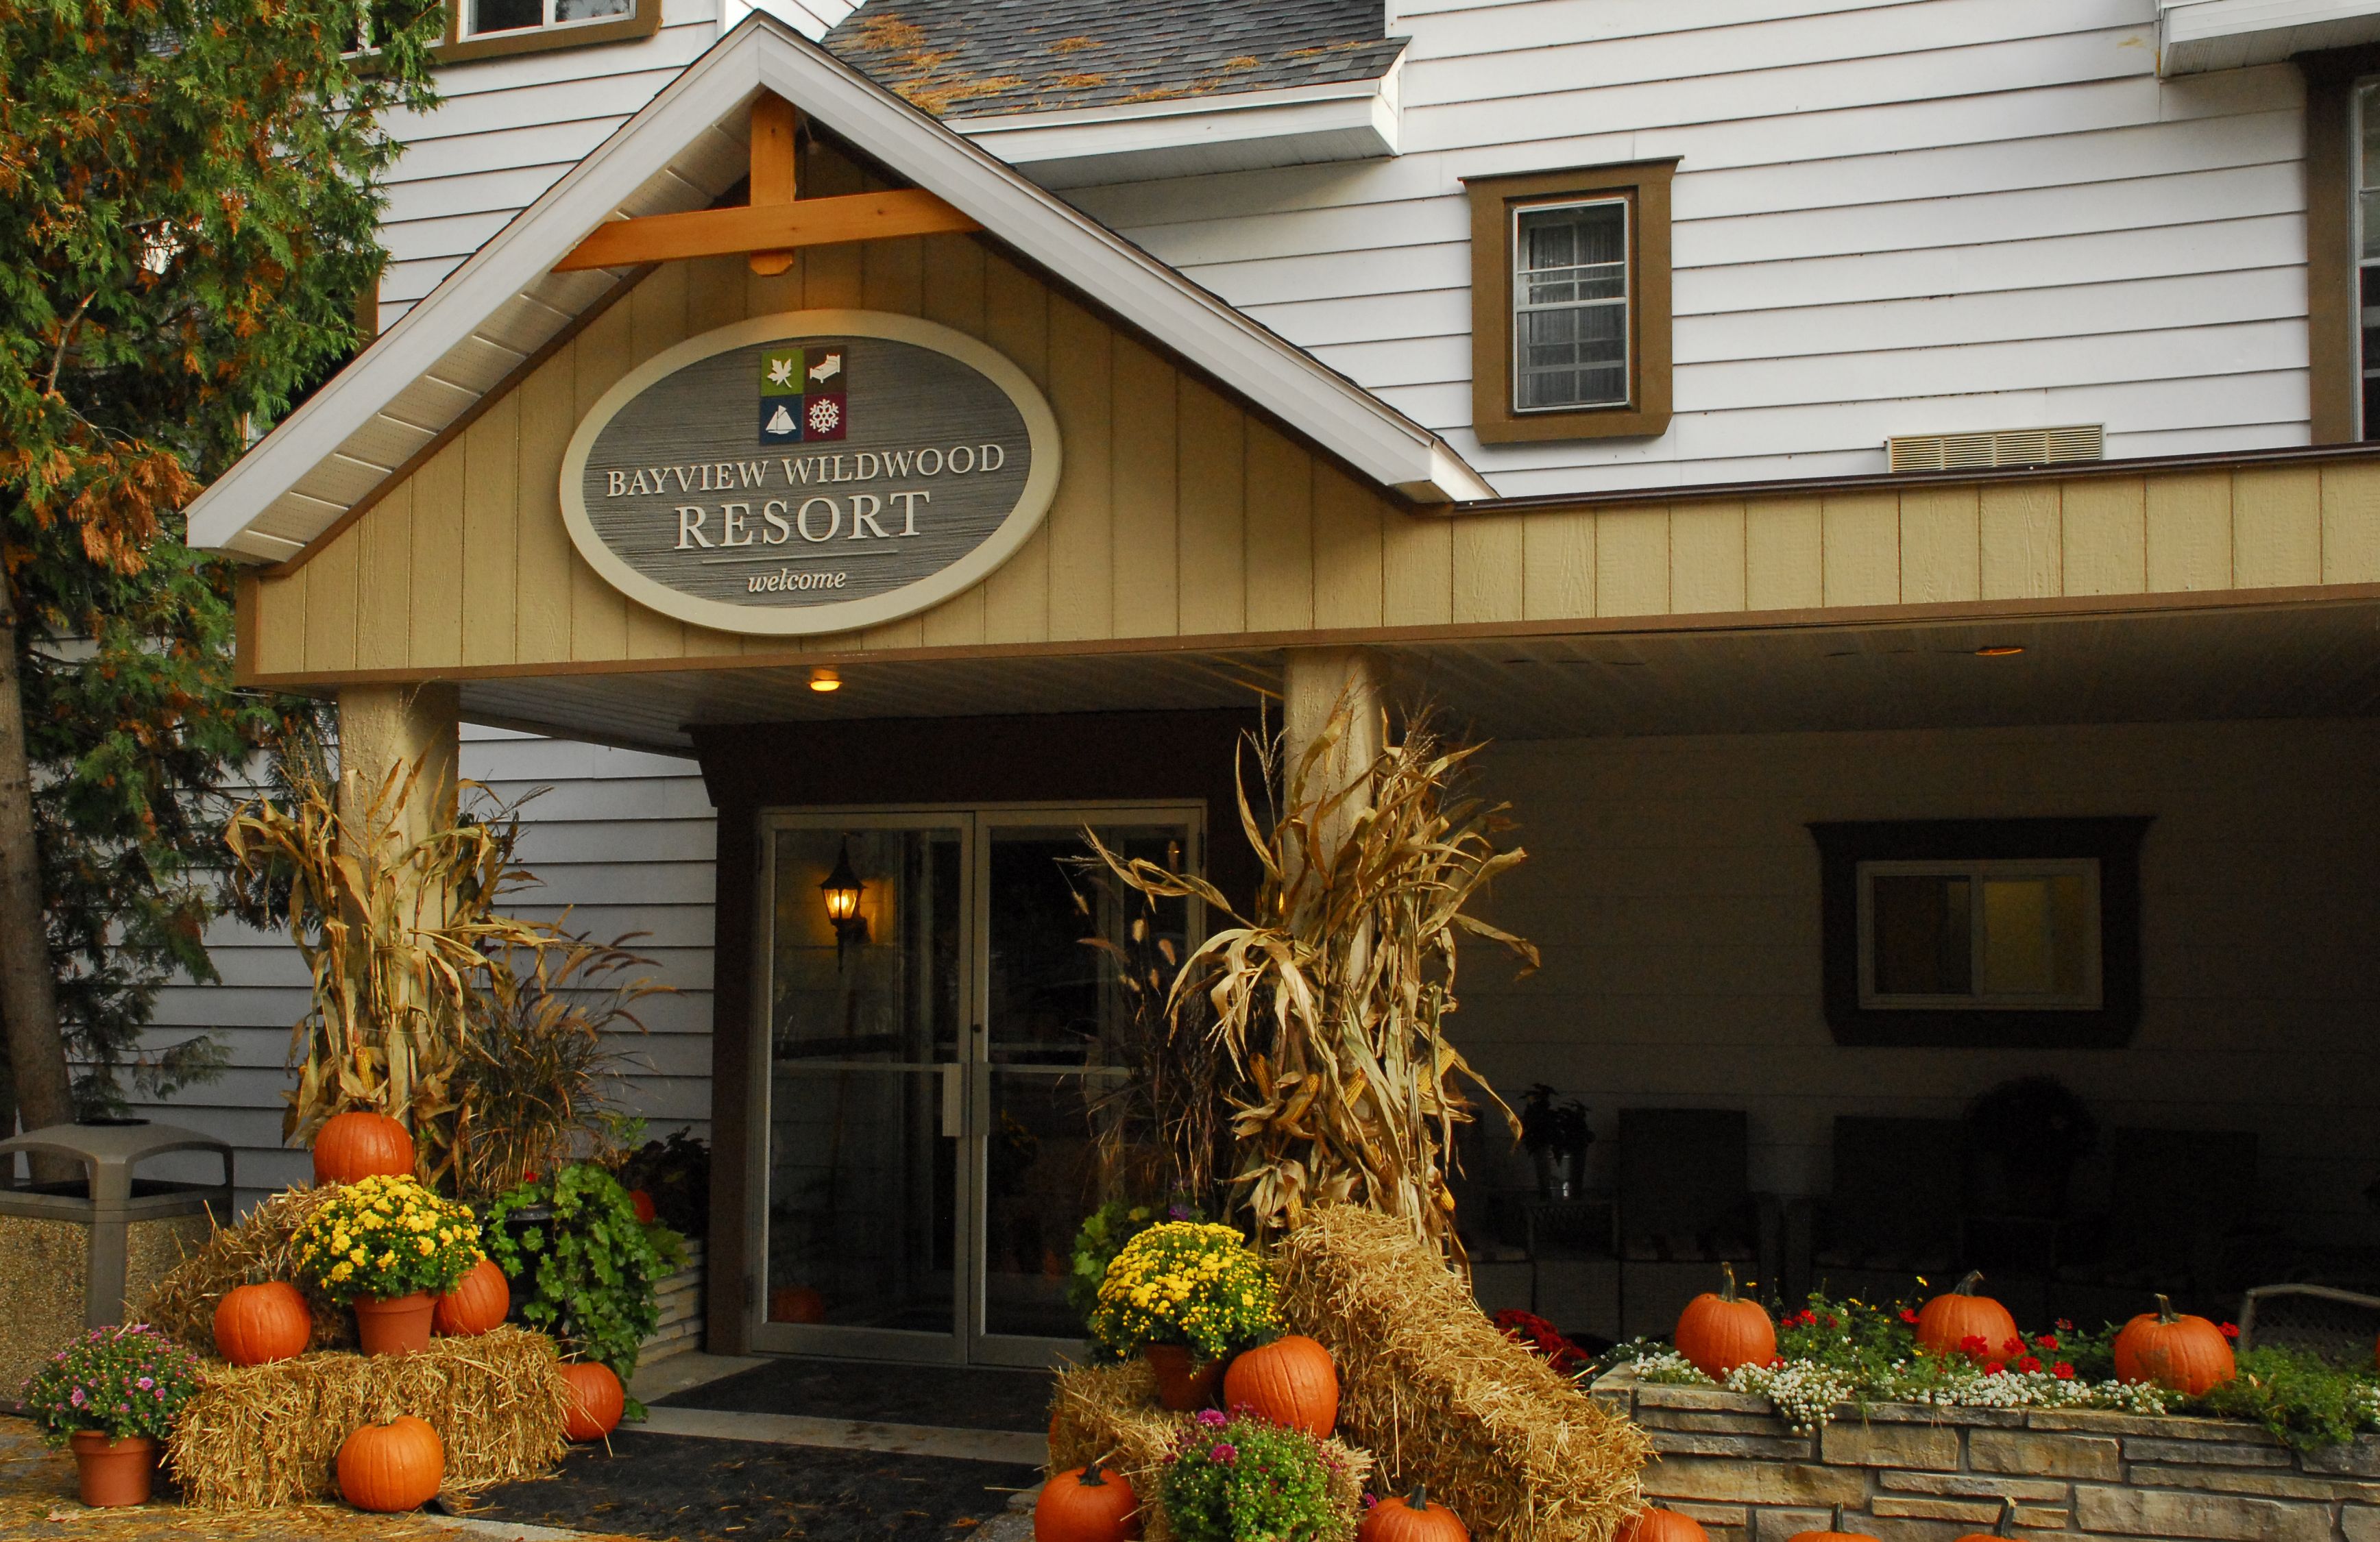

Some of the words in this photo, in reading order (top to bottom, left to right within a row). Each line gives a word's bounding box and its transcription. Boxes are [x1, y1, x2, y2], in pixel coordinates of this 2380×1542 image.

[607, 460, 769, 497] BAYVIEW
[781, 444, 1005, 485] WILDWOOD
[674, 491, 930, 550] RESORT
[748, 567, 847, 593] welcome
